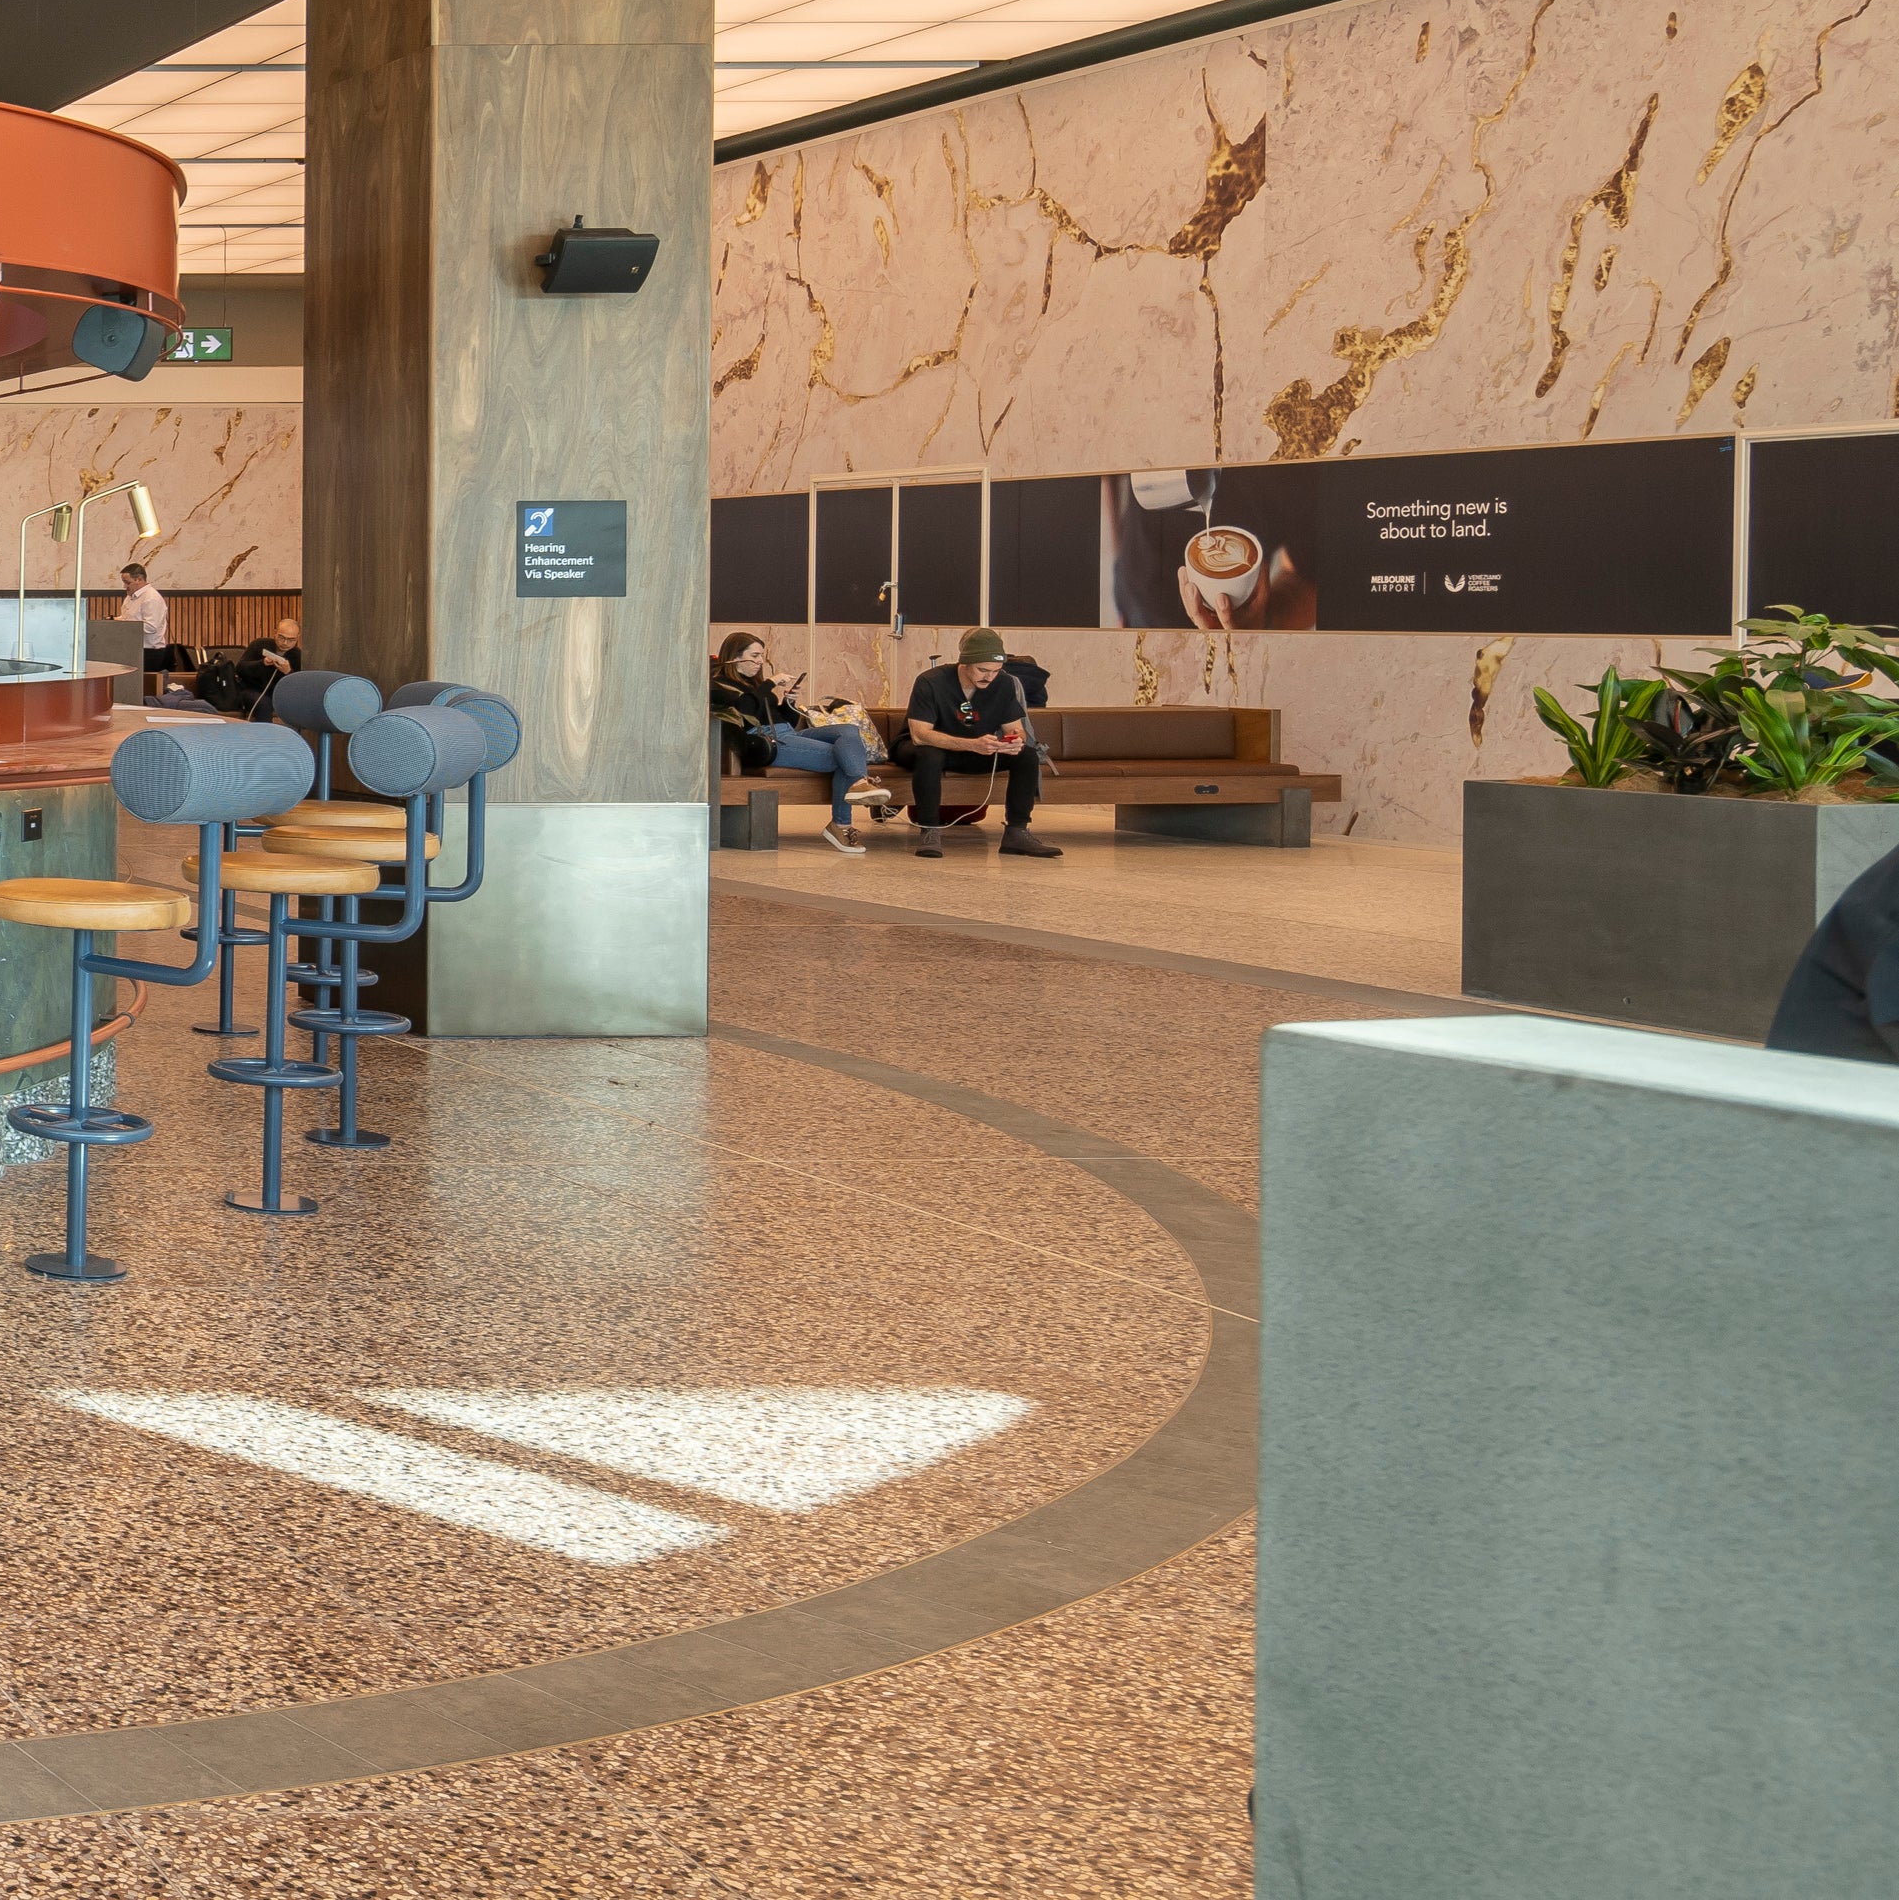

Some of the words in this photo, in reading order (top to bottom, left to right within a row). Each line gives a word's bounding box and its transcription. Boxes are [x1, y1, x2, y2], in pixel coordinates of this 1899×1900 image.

[1366, 499, 1451, 521] Something
[1456, 502, 1490, 515] new
[1494, 497, 1507, 514] is
[1379, 521, 1426, 539] about
[1429, 523, 1446, 538] to
[1451, 518, 1491, 537] land.
[524, 543, 566, 554] Hearing
[524, 556, 594, 566] Enhancement
[524, 569, 542, 579] Via
[544, 569, 586, 580] Speaker
[1370, 575, 1415, 584] MELBOURNE
[1370, 583, 1415, 592] AIRPORT
